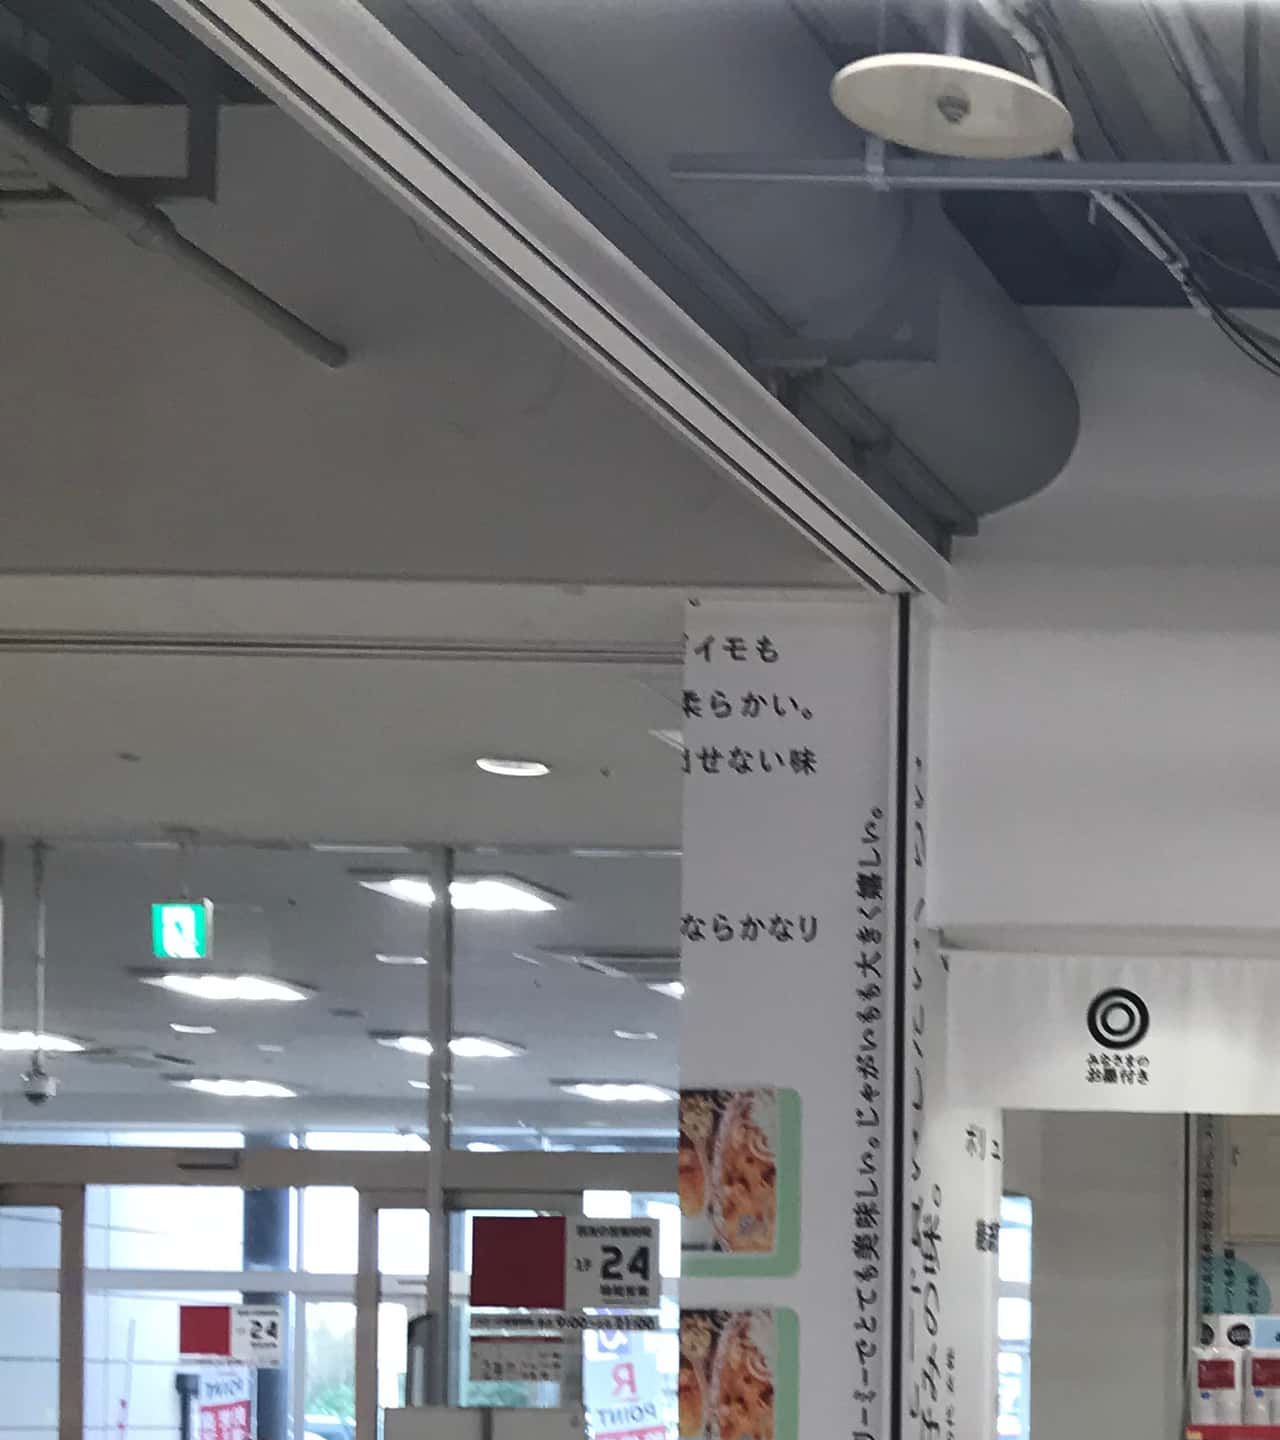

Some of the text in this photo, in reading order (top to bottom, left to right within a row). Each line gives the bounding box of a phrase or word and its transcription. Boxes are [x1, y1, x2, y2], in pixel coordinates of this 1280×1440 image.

[683, 633, 780, 664] イモも
[680, 913, 818, 943] ならかなり
[1086, 1069, 1150, 1085] お墨付き
[600, 1246, 650, 1281] 24
